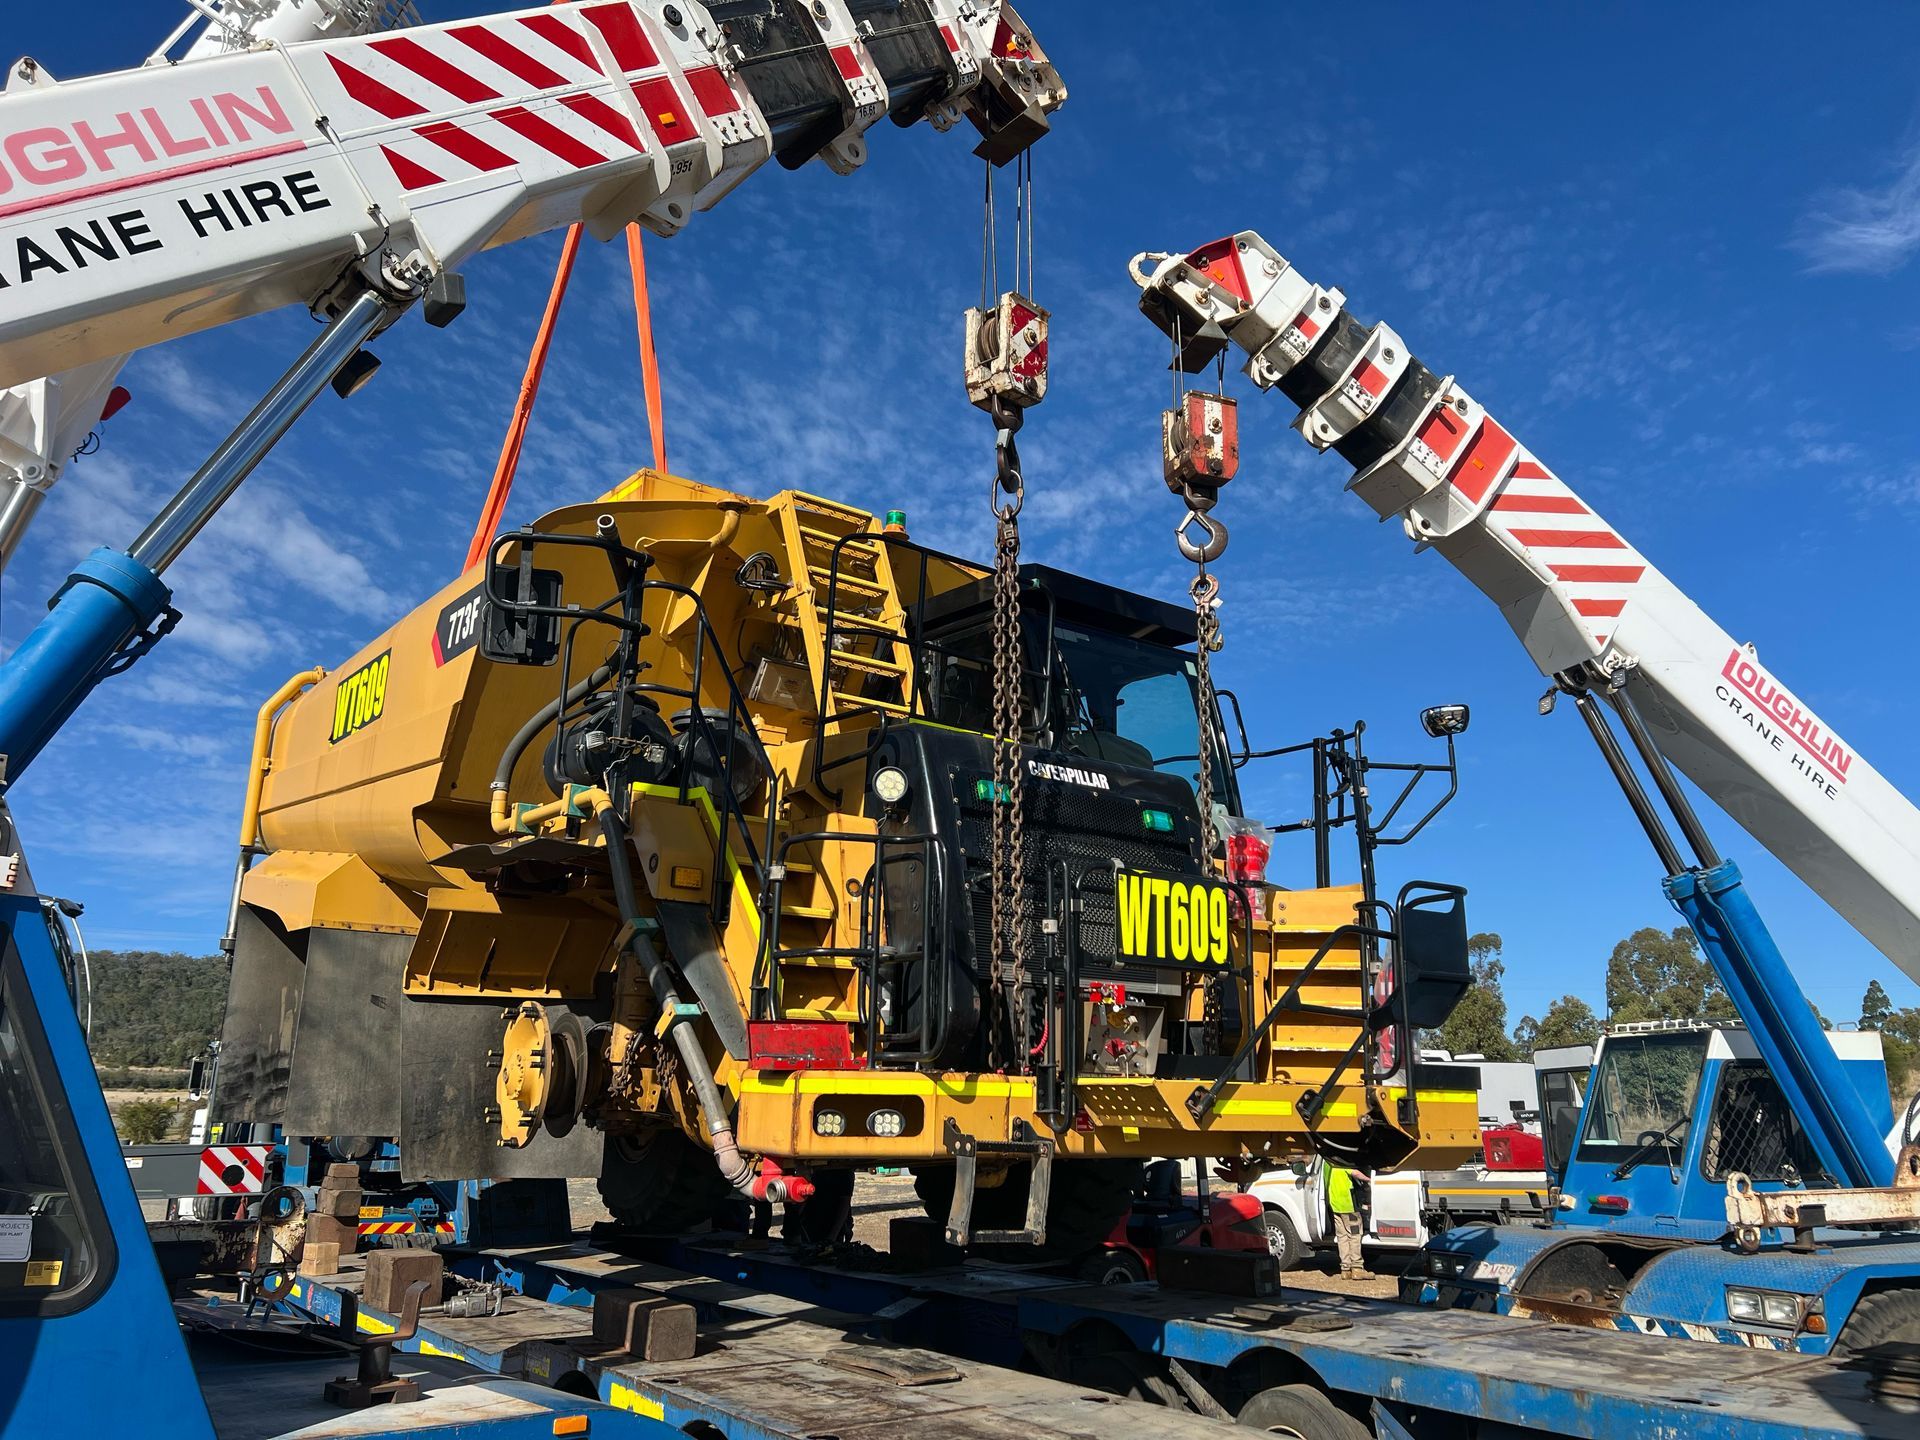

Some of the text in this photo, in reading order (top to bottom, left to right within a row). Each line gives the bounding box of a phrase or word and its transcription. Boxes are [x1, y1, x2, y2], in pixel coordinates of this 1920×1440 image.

[0, 86, 295, 195] GHLIN
[0, 170, 332, 290] ANE HIRE
[447, 595, 481, 649] 773F
[333, 654, 389, 741] WT609
[1715, 685, 1838, 801] CRANE HIRE
[1721, 648, 1853, 781] LOUGHLIN
[1028, 760, 1110, 790] CATERPILLAR
[1118, 873, 1228, 965] WT609
